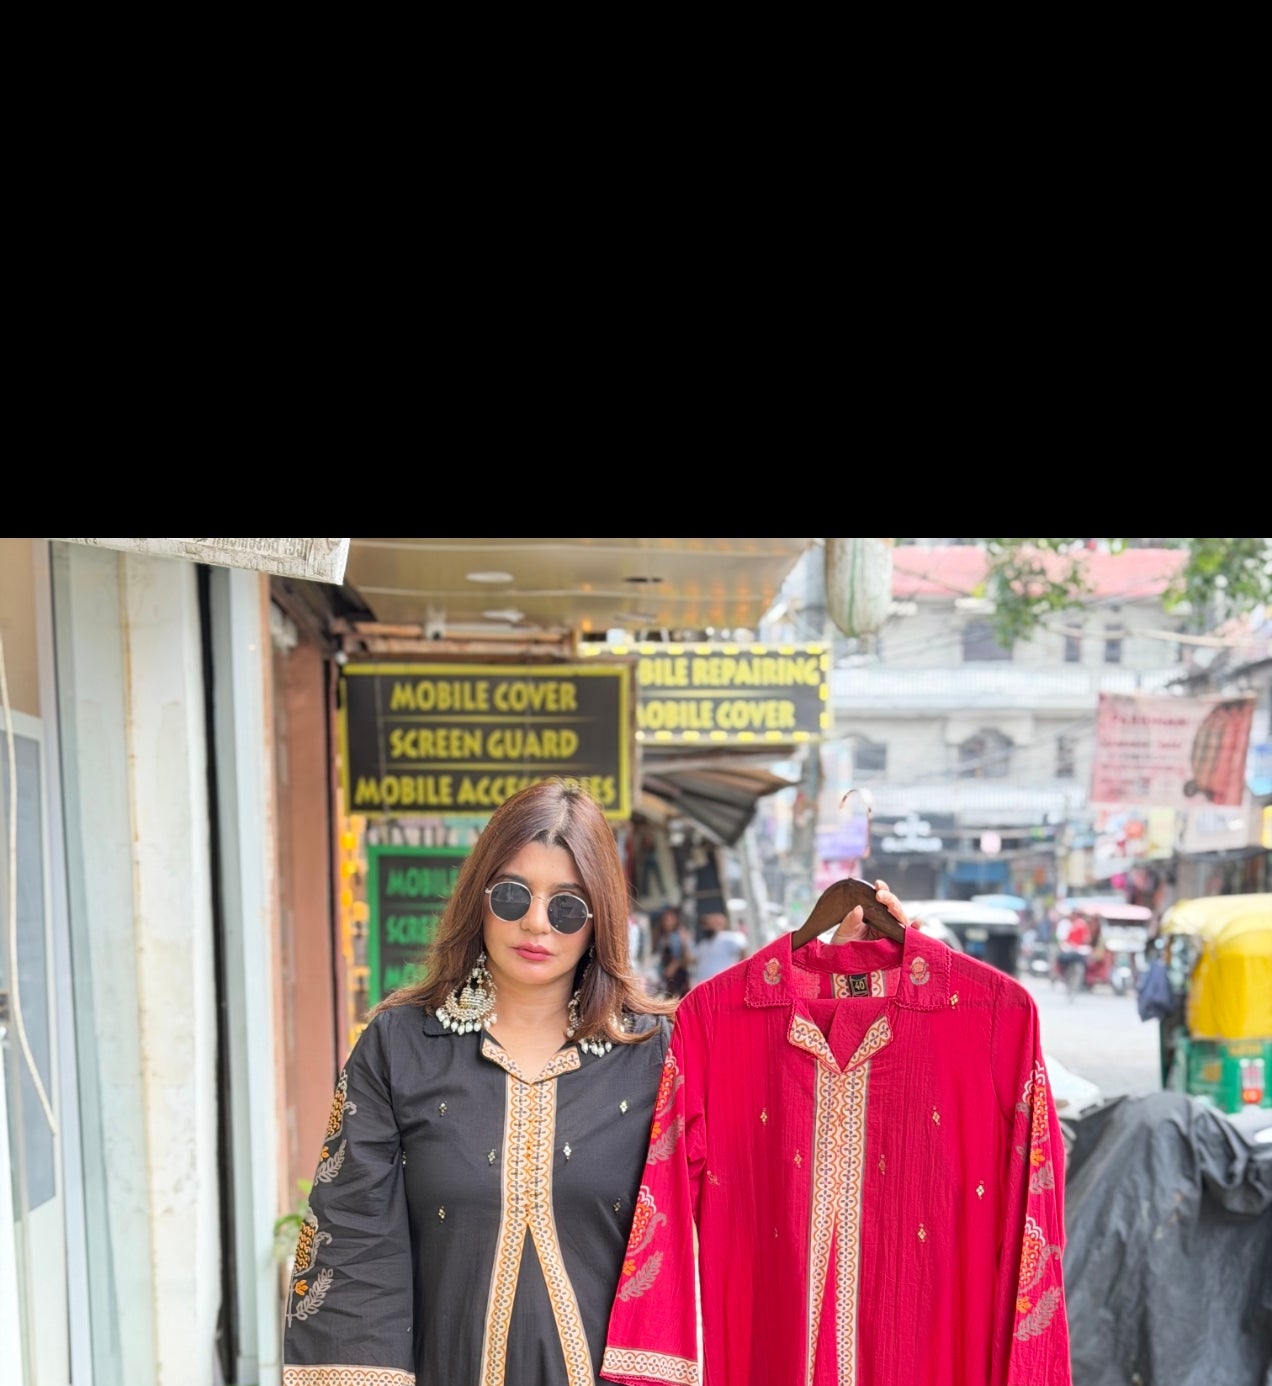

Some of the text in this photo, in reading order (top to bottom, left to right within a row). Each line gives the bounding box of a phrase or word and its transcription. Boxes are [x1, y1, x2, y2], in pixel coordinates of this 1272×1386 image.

[691, 656, 820, 686] REPAIRING
[390, 680, 578, 711] MOBILE COVER
[715, 700, 796, 729] COVER
[389, 728, 579, 758] SCREEN GUARD
[354, 775, 452, 805] MOBILE
